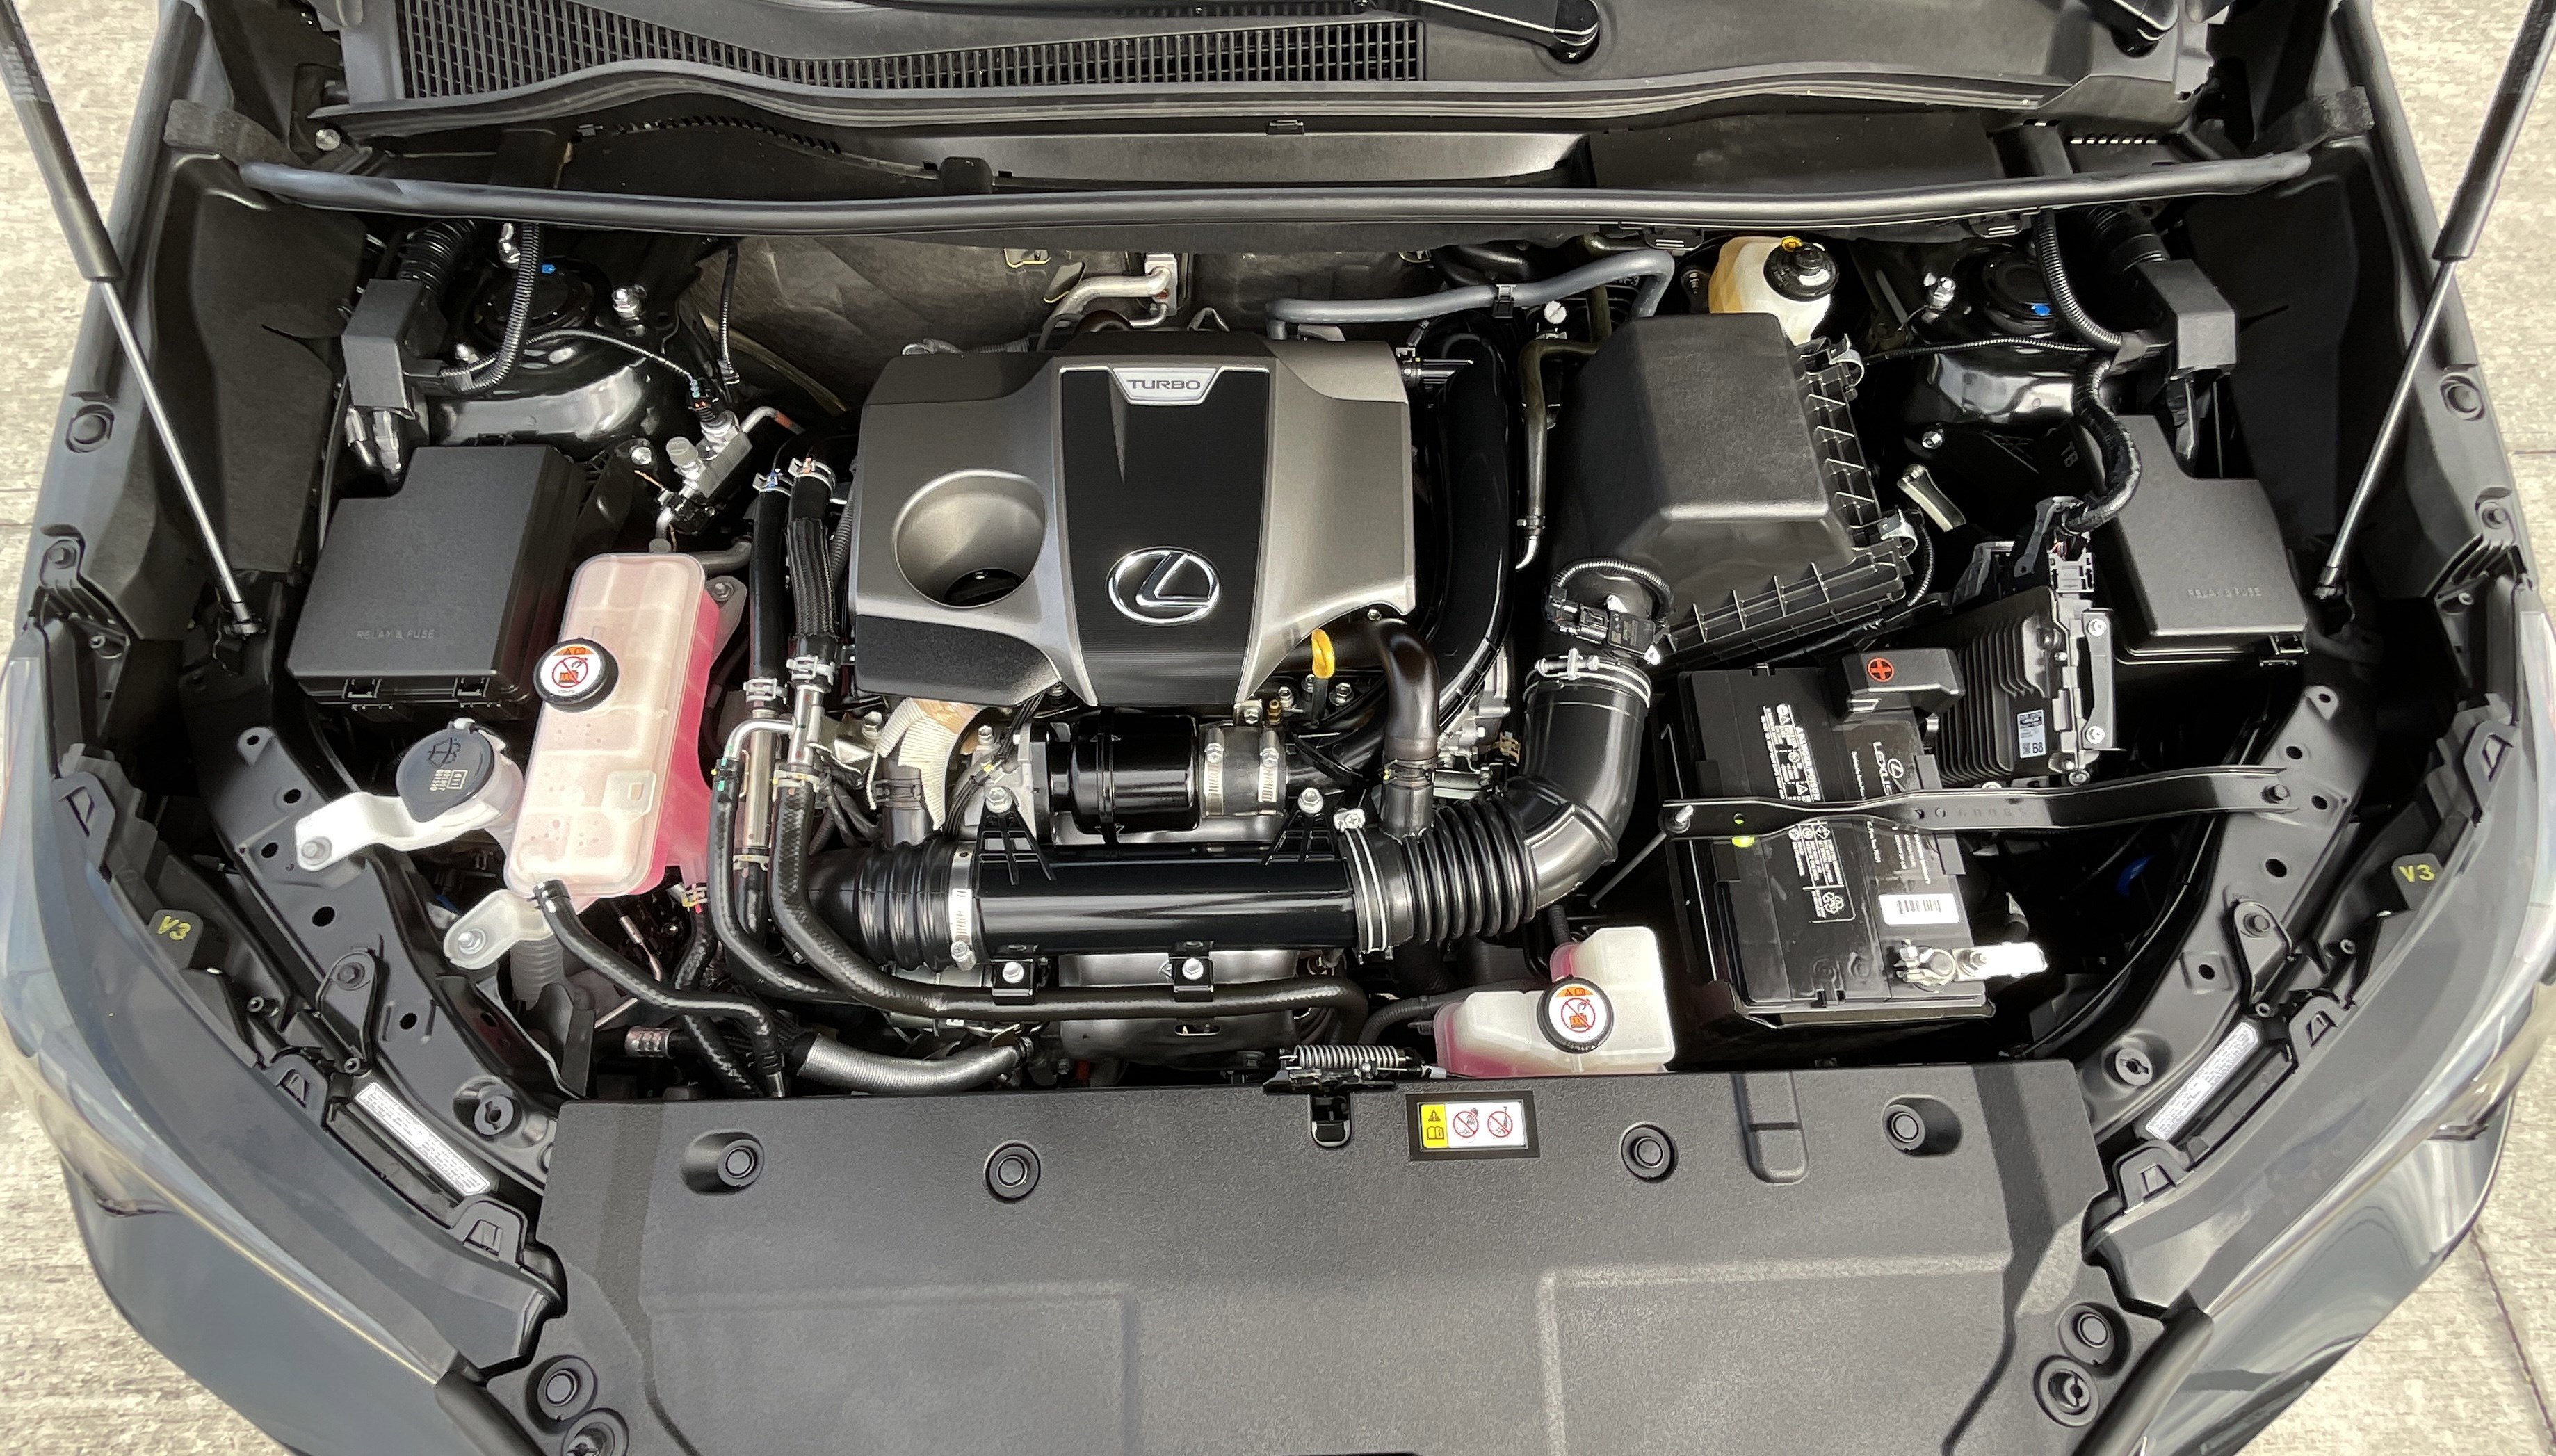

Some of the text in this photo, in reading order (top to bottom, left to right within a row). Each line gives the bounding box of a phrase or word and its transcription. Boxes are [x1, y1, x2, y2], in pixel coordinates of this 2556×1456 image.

[1126, 380, 1201, 390] TURBO
[356, 630, 391, 640] RELAY
[406, 629, 435, 639] FUSE
[2032, 741, 2044, 753] B8
[1872, 741, 1893, 796] LEXUS
[2397, 864, 2435, 883] V3
[156, 915, 191, 941] V3
